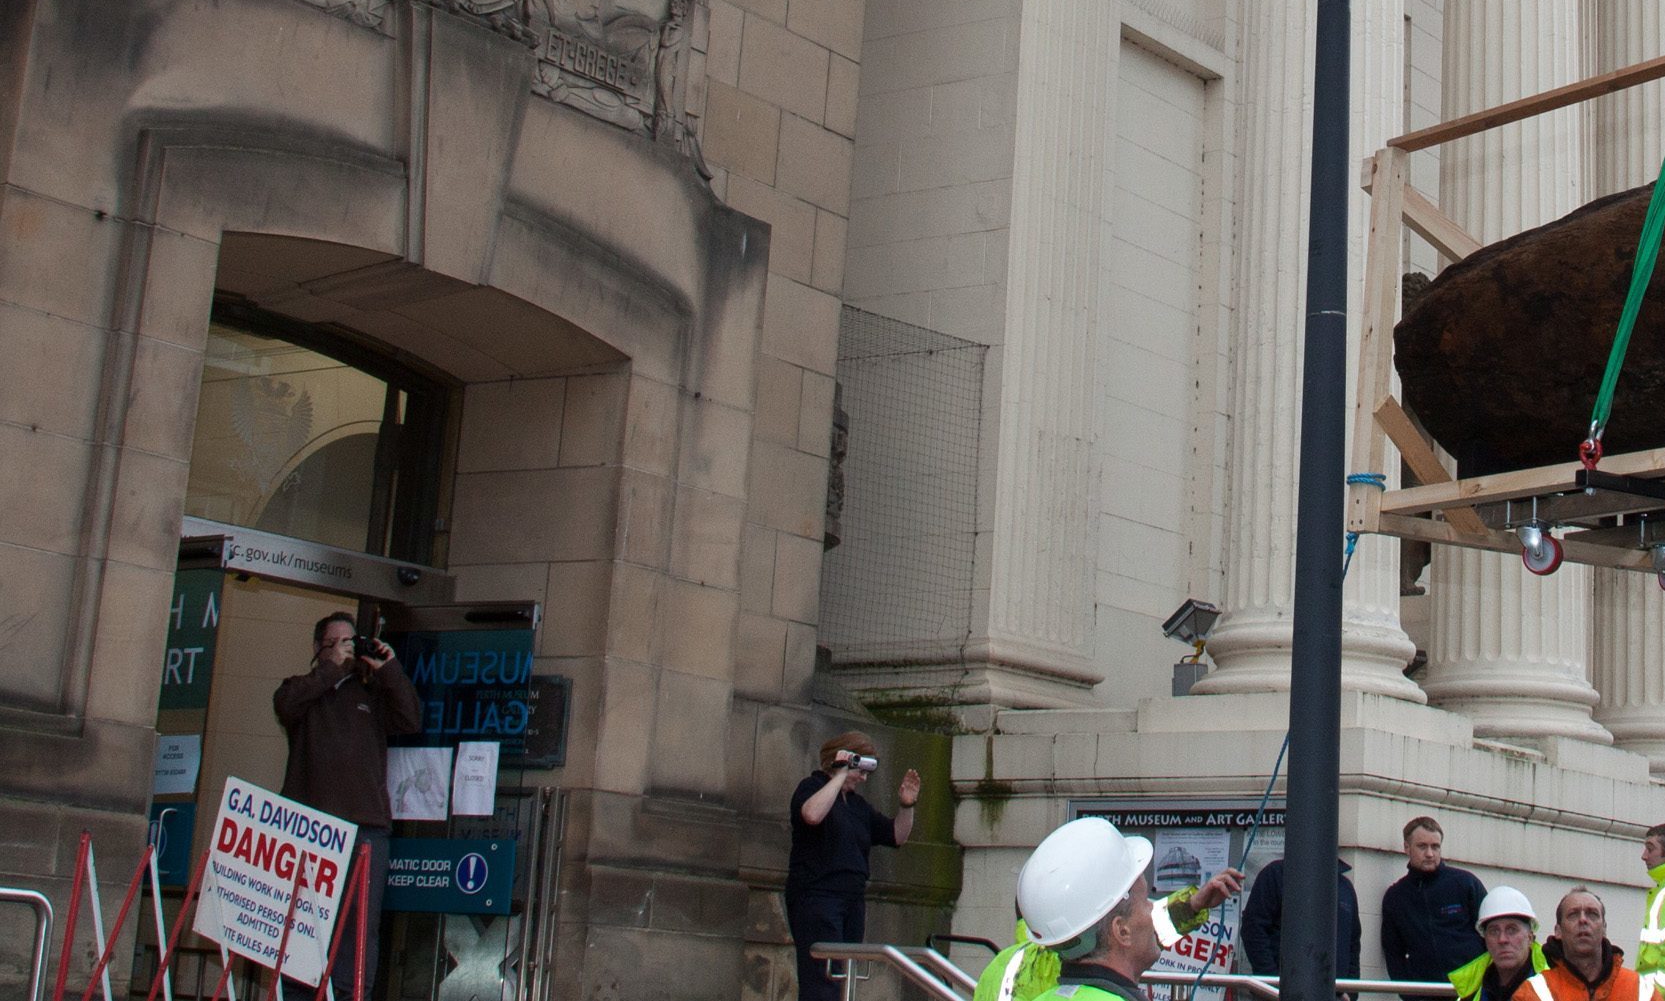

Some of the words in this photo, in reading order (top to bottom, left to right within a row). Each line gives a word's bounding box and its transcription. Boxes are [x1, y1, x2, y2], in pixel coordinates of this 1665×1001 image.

[228, 787, 256, 820] G.A.
[259, 800, 348, 853] DAVIDSON
[1124, 813, 1182, 825] MUSEUM
[1206, 813, 1234, 825] ART
[1236, 812, 1286, 825] GALER
[421, 860, 451, 871] DOOR
[249, 878, 273, 898] WORK
[273, 887, 285, 903] IN
[388, 876, 414, 887] KEEP
[416, 877, 449, 888] CLEAR
[207, 885, 257, 912] THORISED
[296, 922, 318, 939] ONL
[236, 911, 280, 939] ADMITTED
[222, 924, 237, 941] ITE
[236, 933, 262, 953] RULES
[262, 945, 291, 964] APPY
